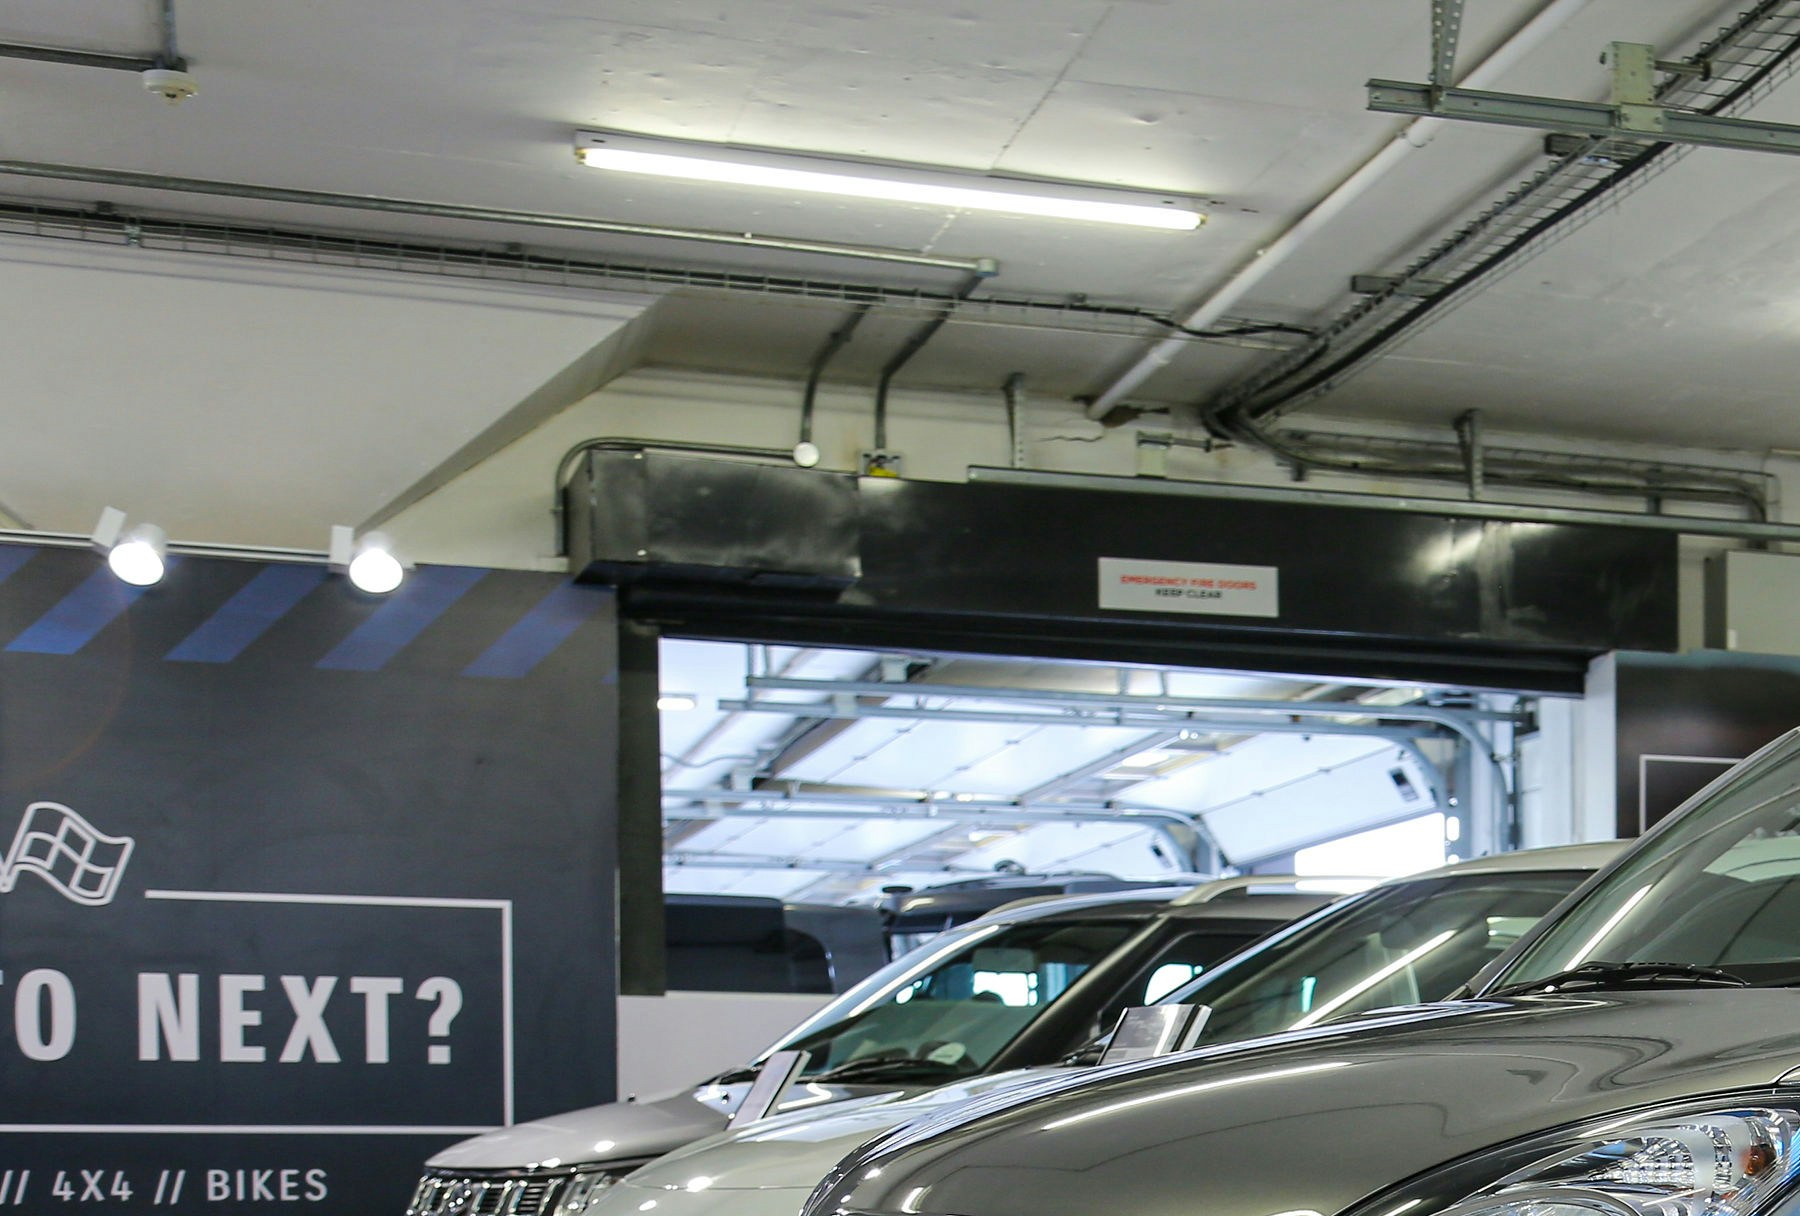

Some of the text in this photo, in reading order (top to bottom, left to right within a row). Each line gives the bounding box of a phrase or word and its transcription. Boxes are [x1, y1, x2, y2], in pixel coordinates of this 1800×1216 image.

[1120, 574, 1257, 591] EMERGENCY FIRE DOORS
[1155, 588, 1223, 599] KEEP CLEAR
[0, 968, 464, 1065] O NEXT?
[52, 1169, 134, 1202] 4X4
[207, 1168, 328, 1202] BIKES
